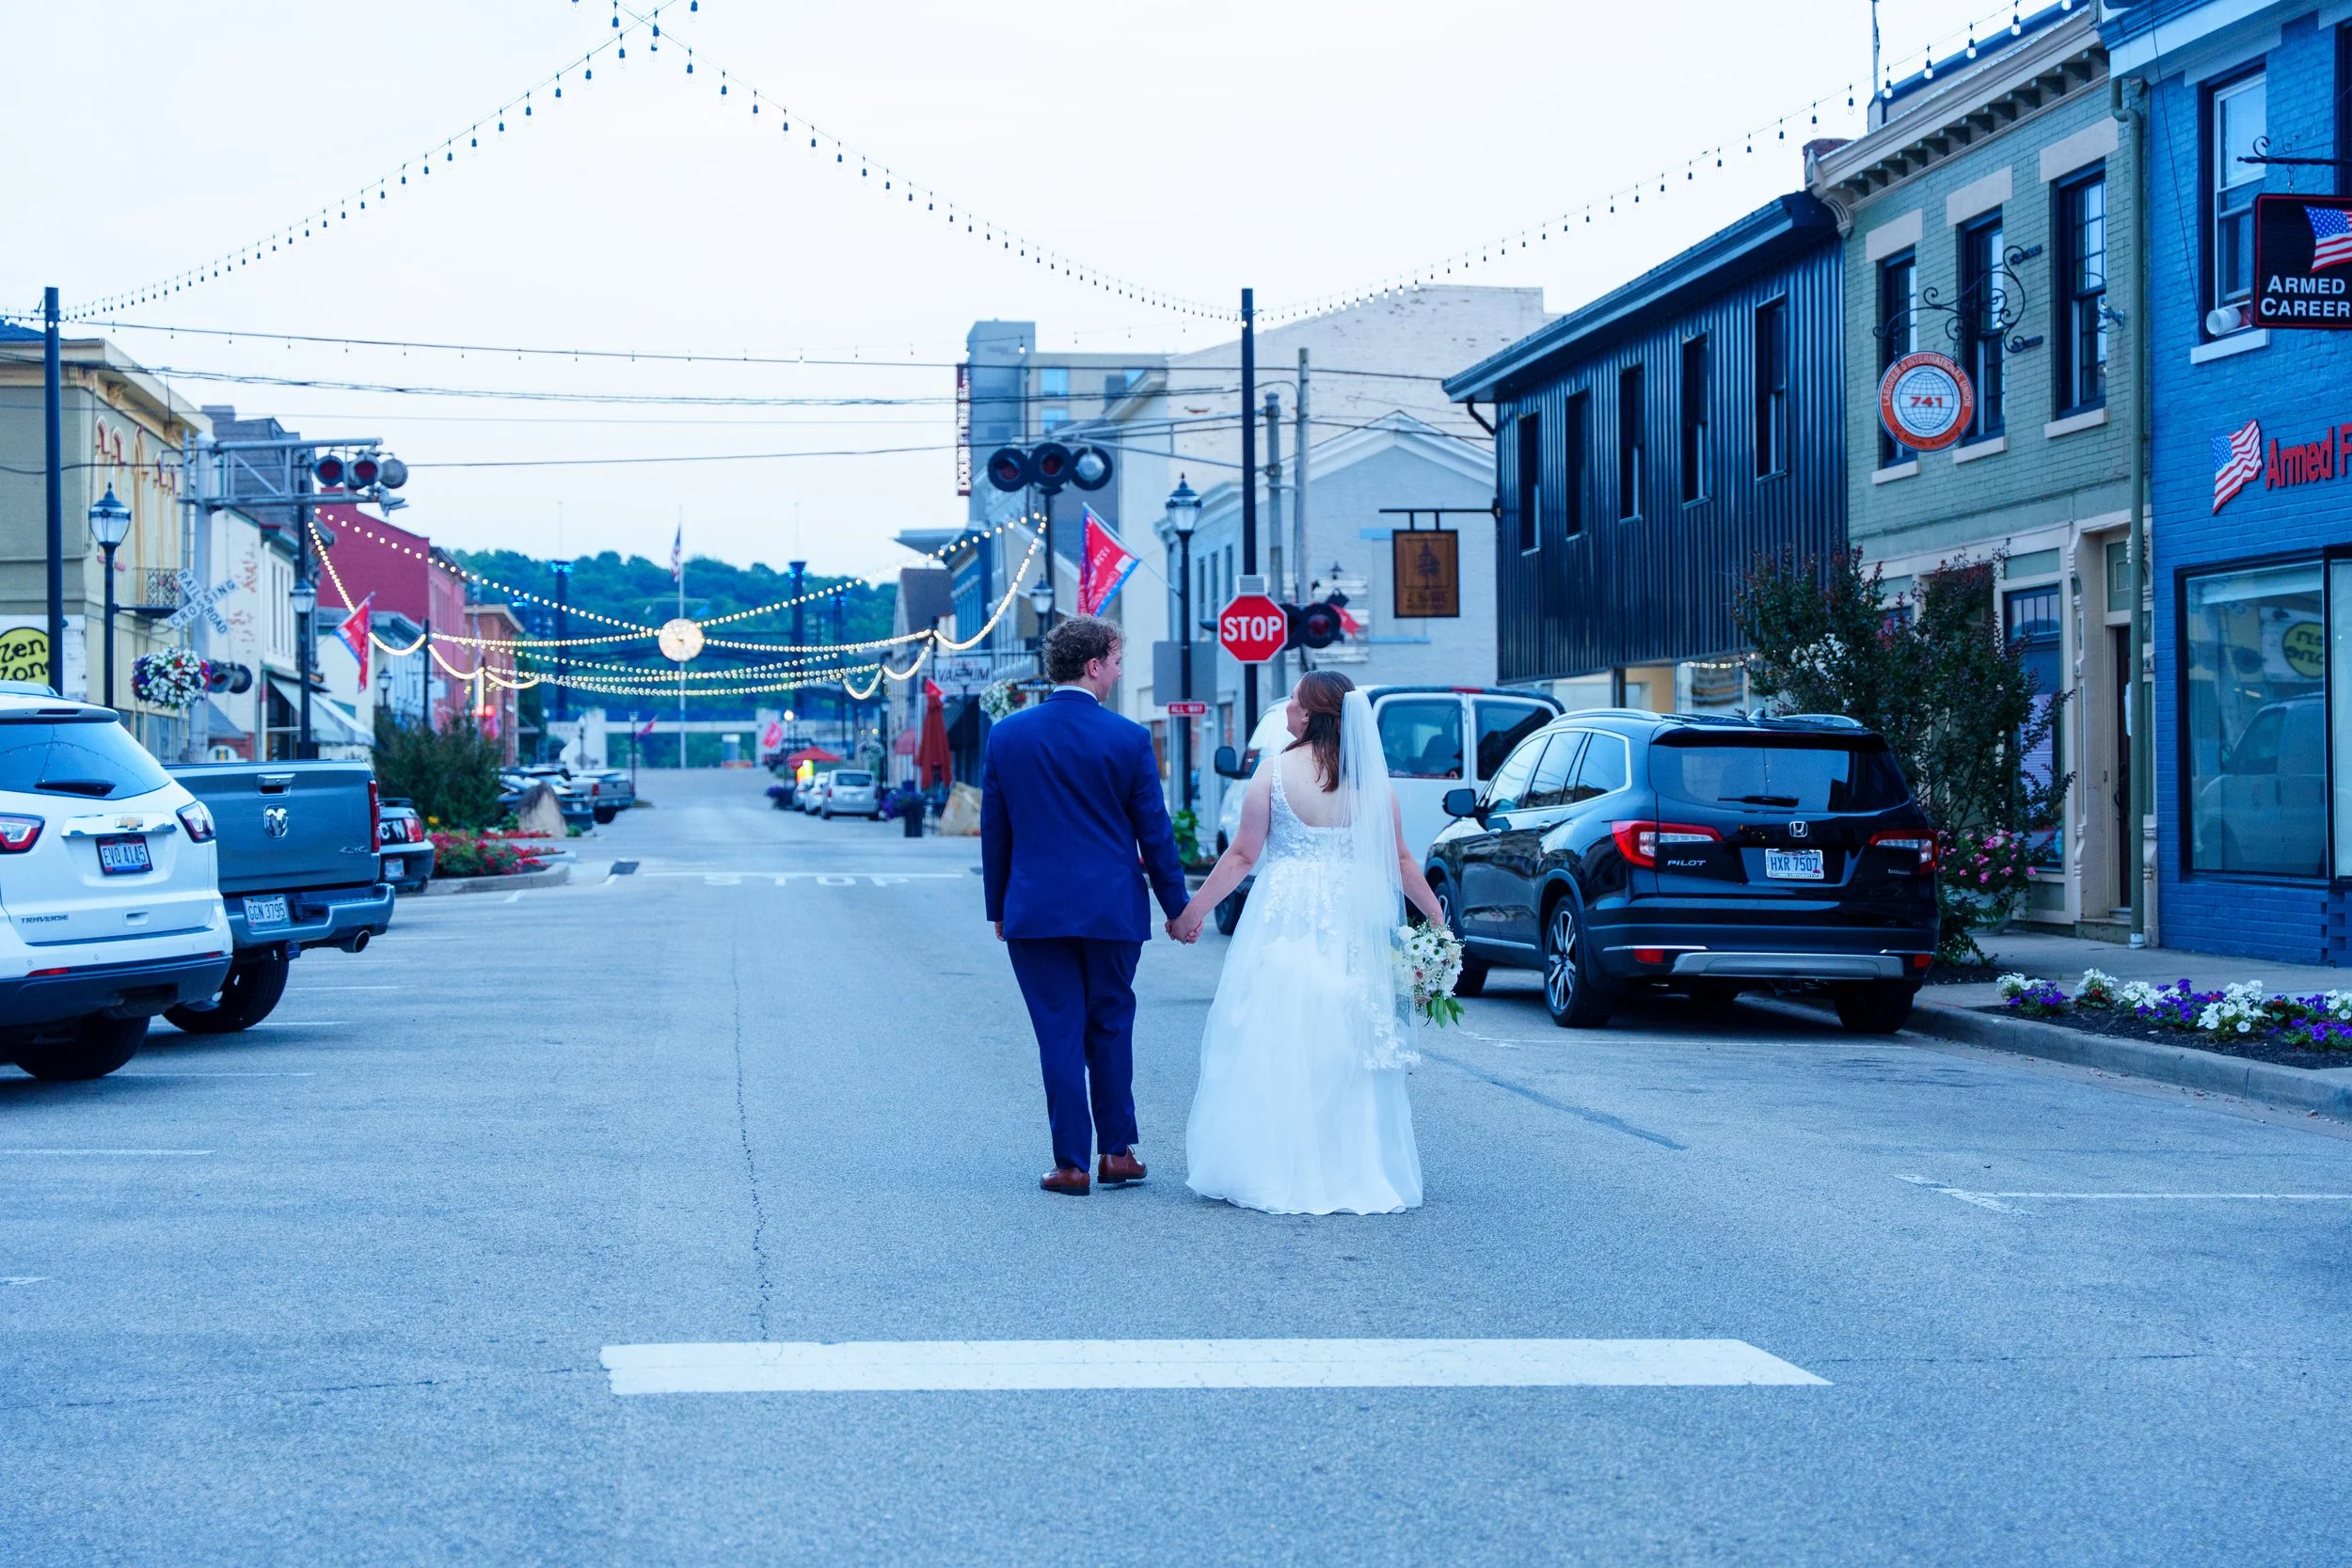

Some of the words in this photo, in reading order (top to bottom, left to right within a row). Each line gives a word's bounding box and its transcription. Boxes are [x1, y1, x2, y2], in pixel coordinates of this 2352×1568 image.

[2266, 275, 2345, 294] ARMED
[2260, 297, 2351, 318] CAREER
[1906, 355, 1961, 381] INTERNATIONAL
[1960, 379, 1972, 407] UNION
[1911, 396, 1943, 407] 741
[2265, 427, 2333, 489] Armed
[1223, 616, 1282, 641] STOP
[0, 640, 46, 663] Zen
[123, 845, 147, 863] 4145
[1771, 856, 1790, 871] HXR
[1792, 857, 1819, 872] 7507
[21, 914, 69, 924] TRAVERSE
[247, 904, 264, 920] GGN
[264, 902, 286, 919] 3795
